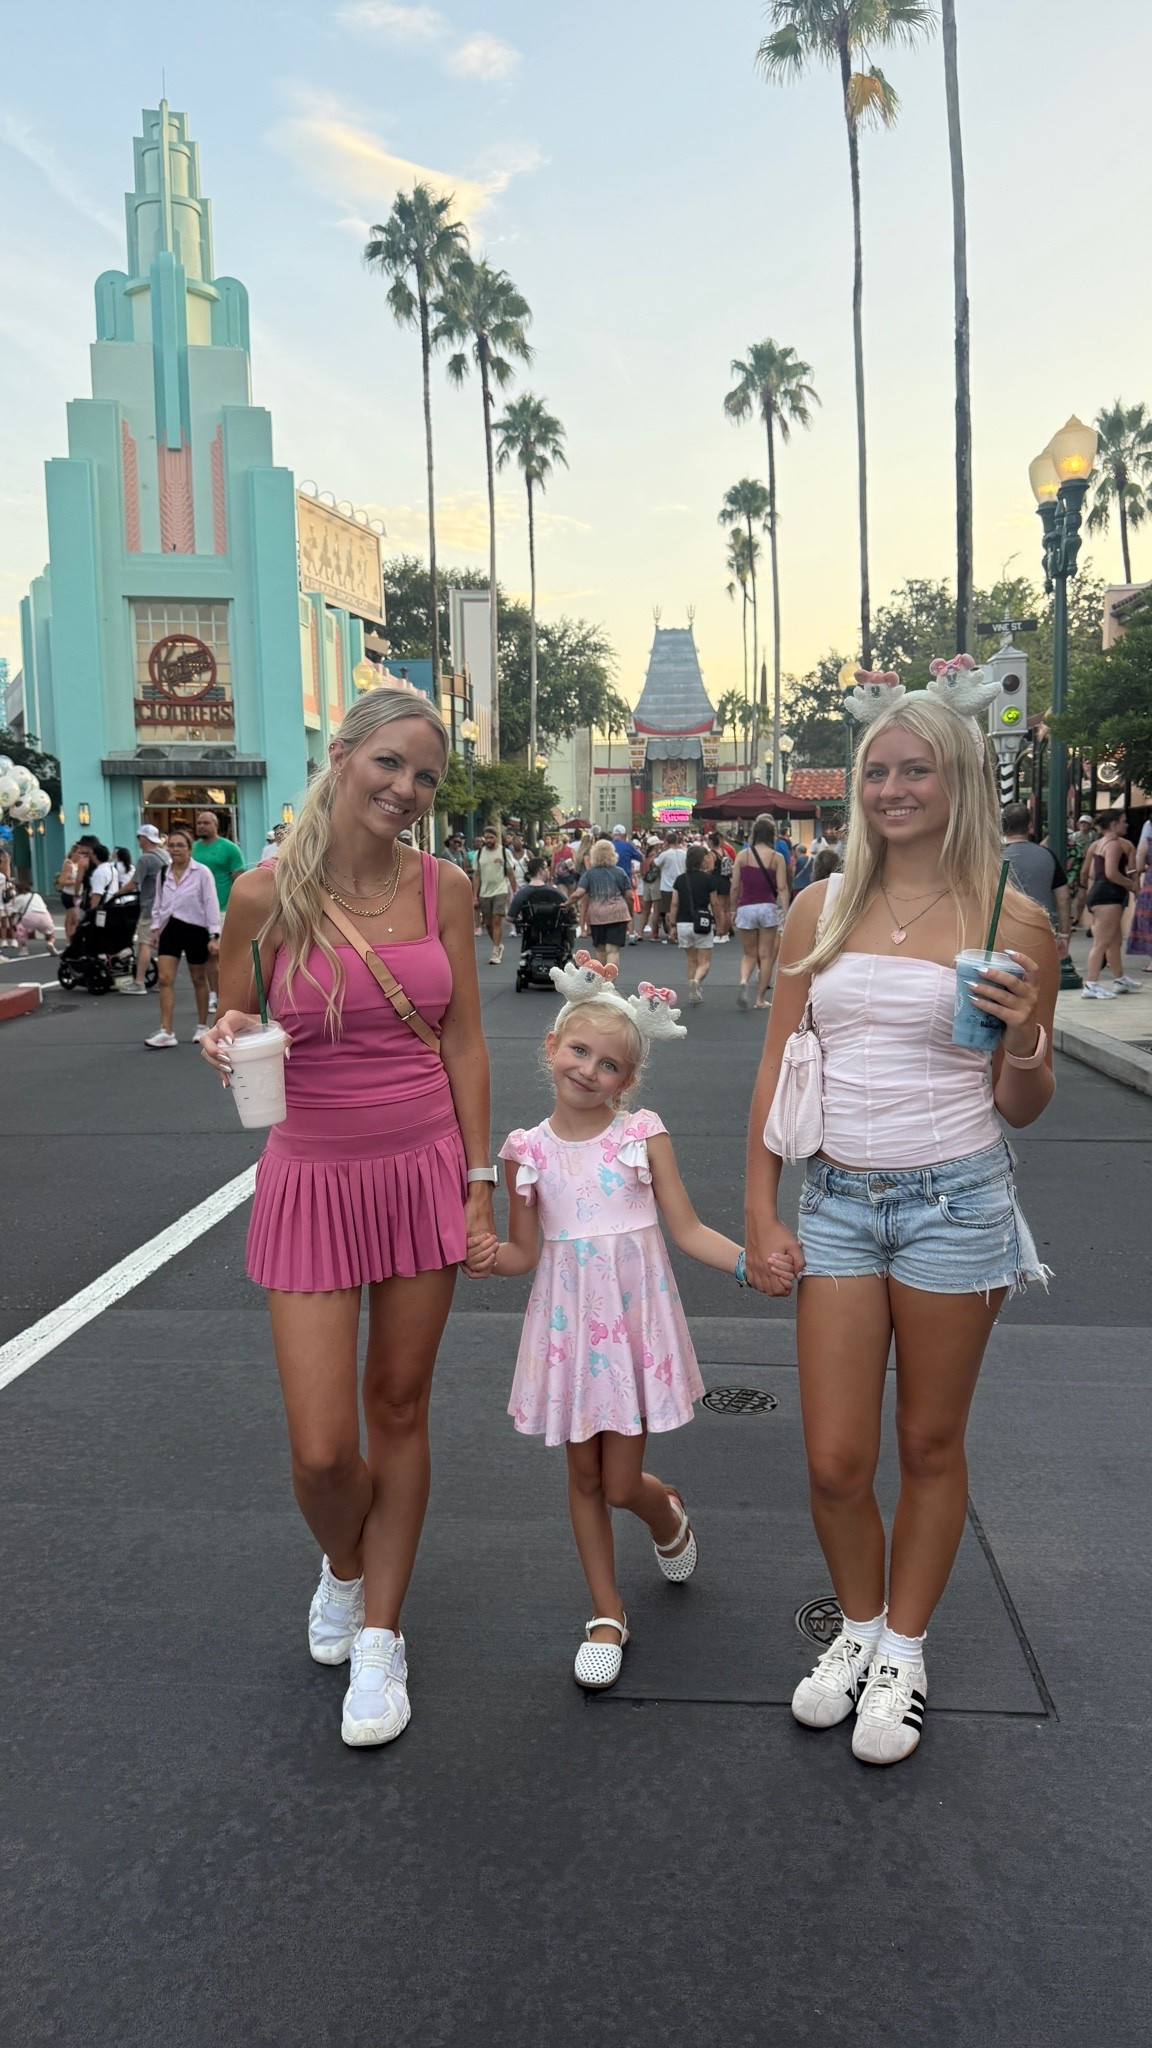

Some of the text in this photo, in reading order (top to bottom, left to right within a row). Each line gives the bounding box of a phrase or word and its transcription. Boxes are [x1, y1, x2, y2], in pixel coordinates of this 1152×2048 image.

[992, 622, 1023, 632] VINE ST.
[138, 703, 232, 721] CLOTHIERS
[810, 1619, 844, 1631] WA
